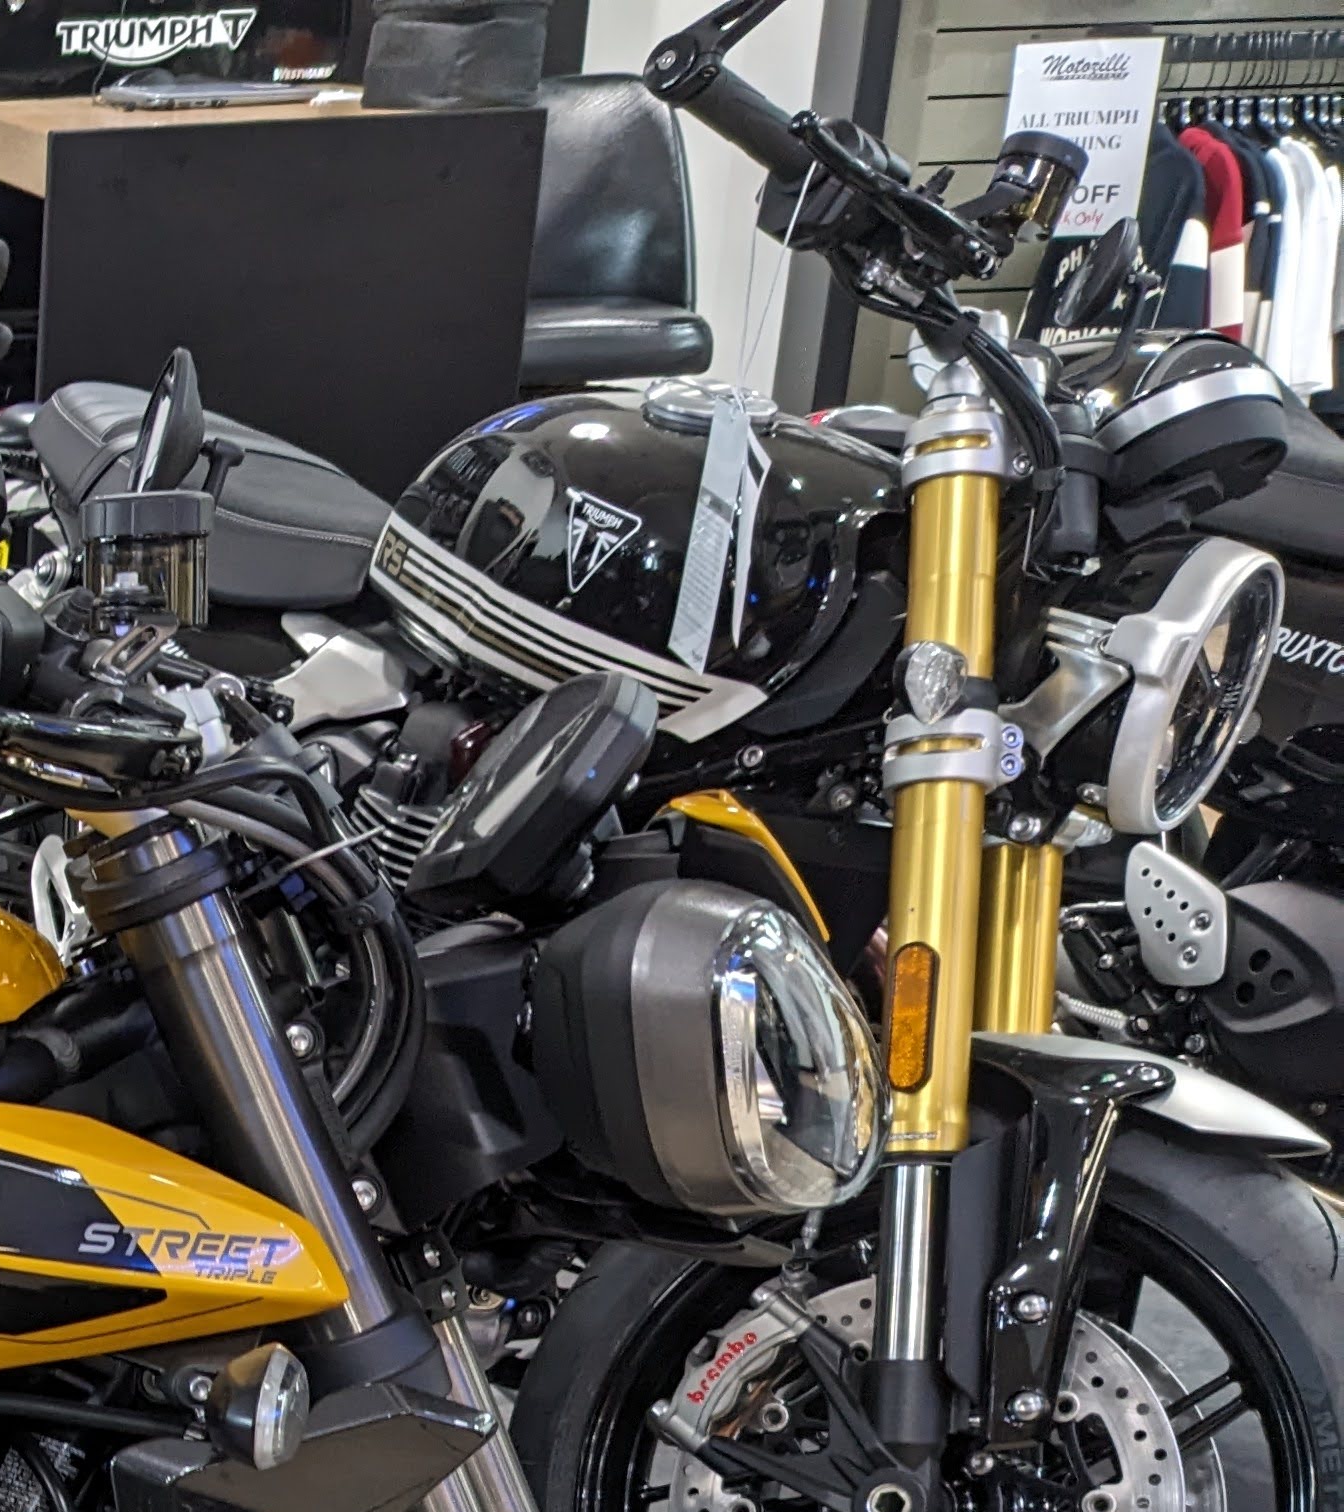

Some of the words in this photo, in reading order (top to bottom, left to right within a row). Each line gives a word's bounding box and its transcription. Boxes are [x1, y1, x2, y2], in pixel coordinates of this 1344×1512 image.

[56, 14, 213, 62] TRIUMPH
[1043, 53, 1131, 75] Motorilli
[1017, 113, 1050, 129] ALL
[1054, 108, 1139, 127] TRIUMPH
[1072, 134, 1121, 150] HING
[1072, 184, 1121, 204] OFF
[582, 502, 624, 531] TRIUMPH
[78, 1222, 290, 1268] STREET
[193, 1264, 278, 1286] TRIPLE
[686, 1331, 758, 1404] brembo
